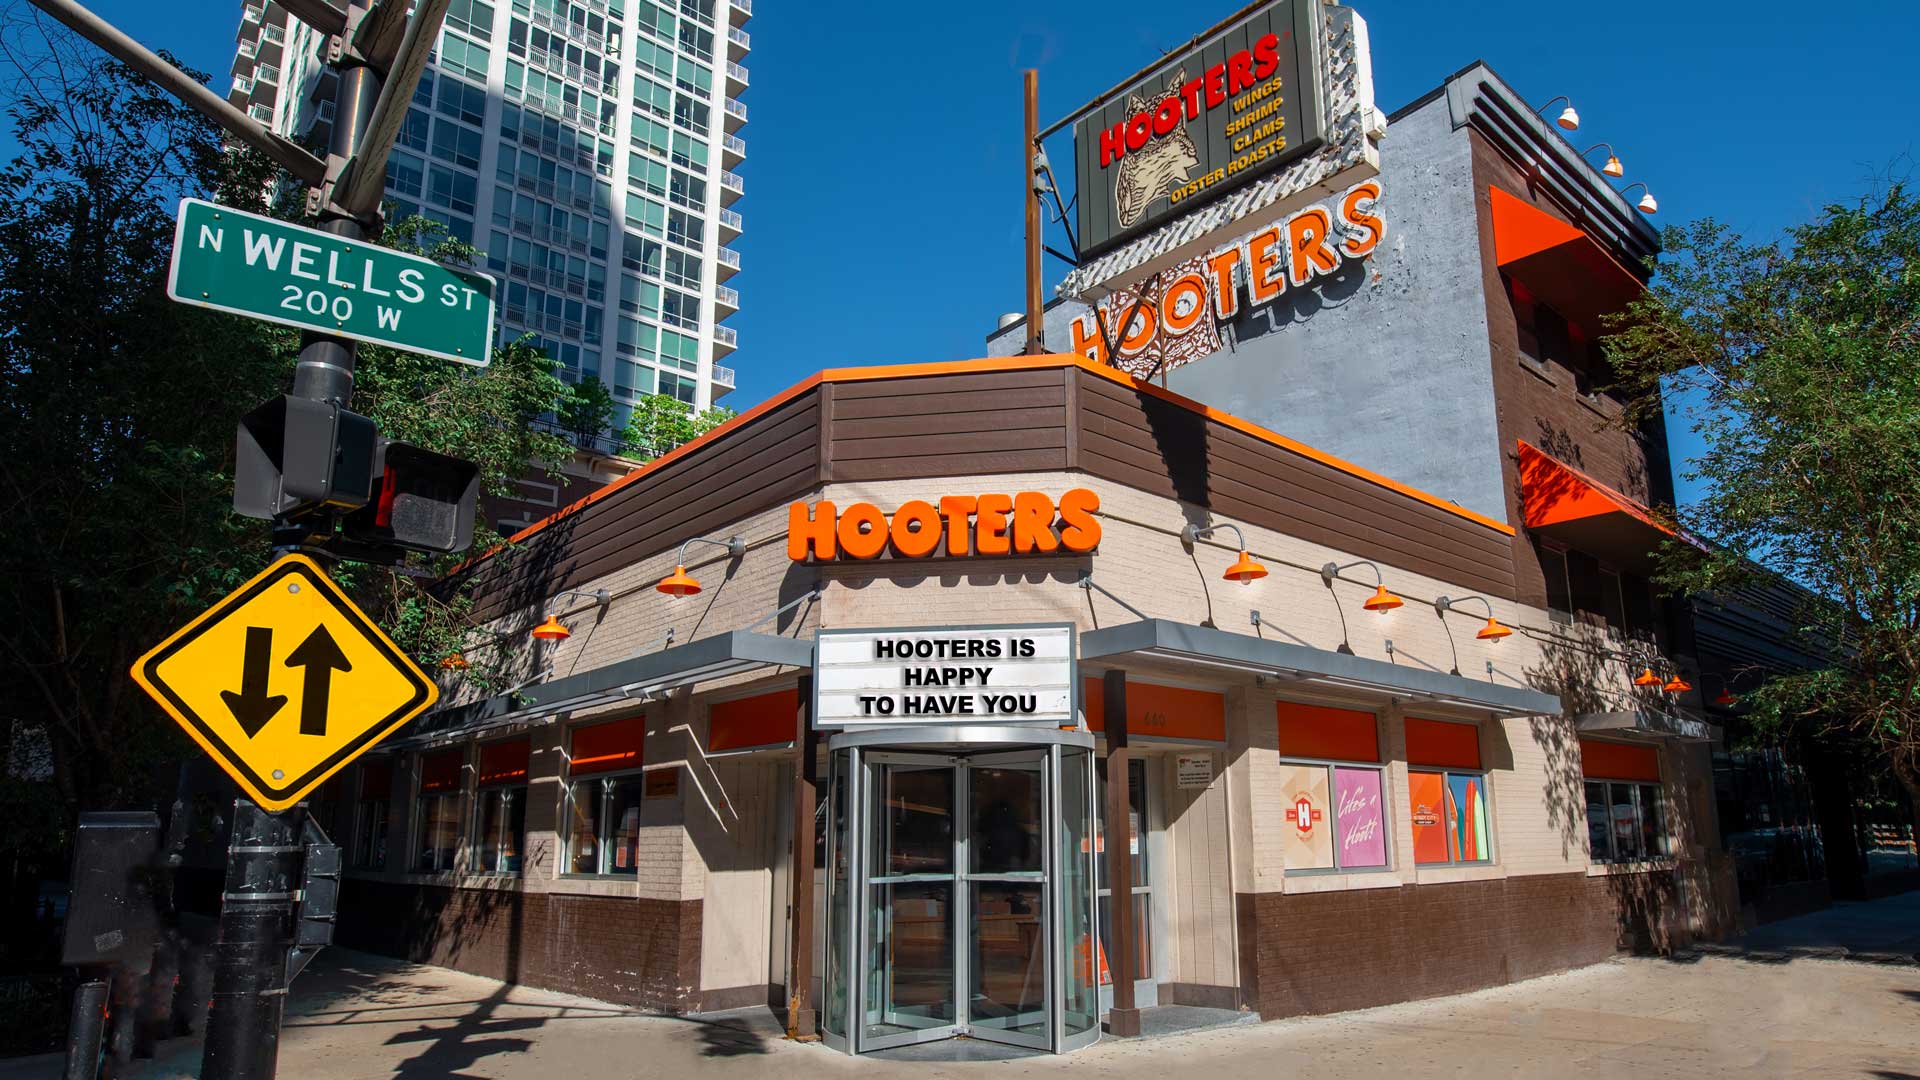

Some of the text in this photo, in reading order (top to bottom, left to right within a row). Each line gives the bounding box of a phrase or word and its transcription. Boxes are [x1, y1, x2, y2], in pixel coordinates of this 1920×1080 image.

[1100, 32, 1281, 169] HOOTERS
[1233, 77, 1282, 113] WINGS
[1225, 96, 1284, 137] SHRIMP
[1234, 116, 1285, 153] CLAMS
[1171, 136, 1287, 203] OYSTER ROASTS
[199, 224, 478, 311] N WELLS ST
[1069, 177, 1387, 366] HOOTERS
[281, 285, 402, 332] 200 W
[788, 488, 1103, 562] HOOTERS
[876, 639, 1036, 659] HOOTERS IS
[904, 667, 993, 686] HAPPY
[860, 695, 1038, 715] TO HAVE YOU
[1298, 803, 1311, 827] H
